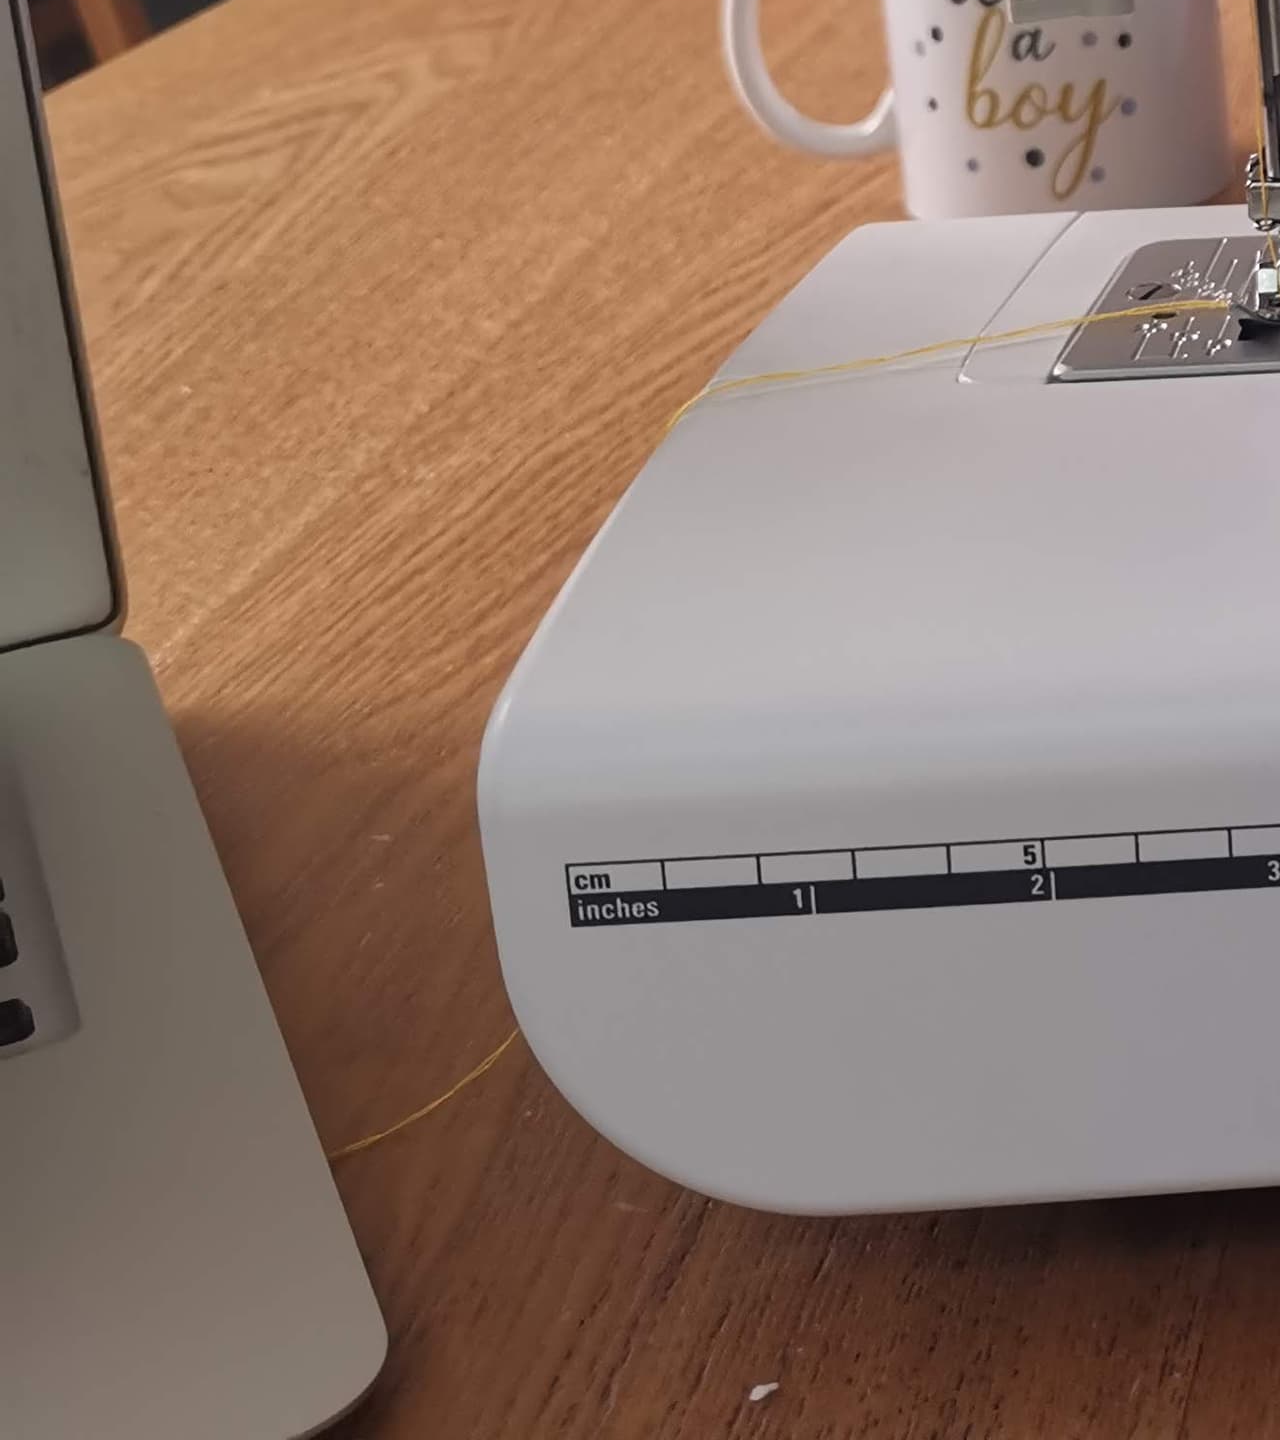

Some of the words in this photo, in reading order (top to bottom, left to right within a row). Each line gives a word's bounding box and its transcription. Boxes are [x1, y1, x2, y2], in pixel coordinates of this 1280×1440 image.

[1012, 27, 1055, 61] a
[965, 8, 1121, 201] boy
[574, 870, 611, 891] cm
[1023, 844, 1036, 866] 5
[577, 896, 660, 921] inches
[792, 887, 803, 909] 1
[1030, 873, 1045, 896] 2
